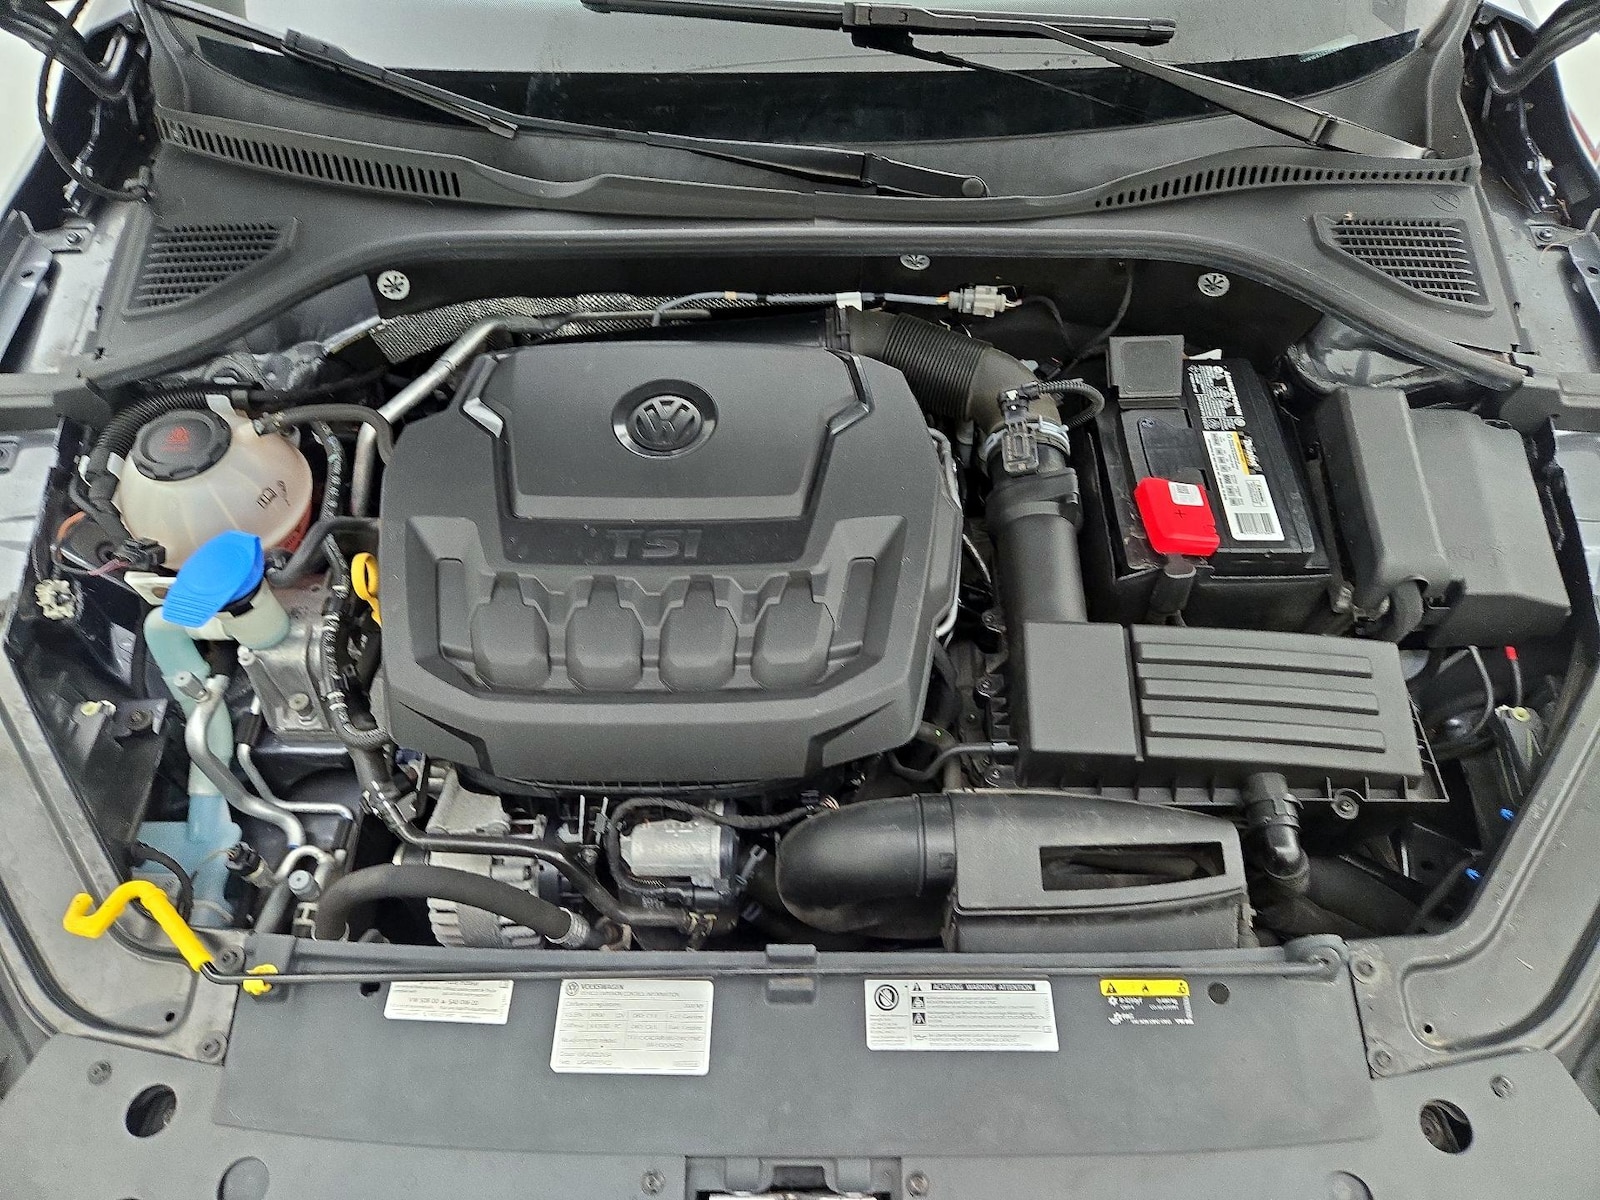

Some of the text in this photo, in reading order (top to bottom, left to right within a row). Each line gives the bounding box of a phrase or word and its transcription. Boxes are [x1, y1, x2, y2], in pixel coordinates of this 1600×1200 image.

[605, 528, 703, 559] TSI
[933, 983, 1033, 991] ACHTUNG WARNING ATTENTION
